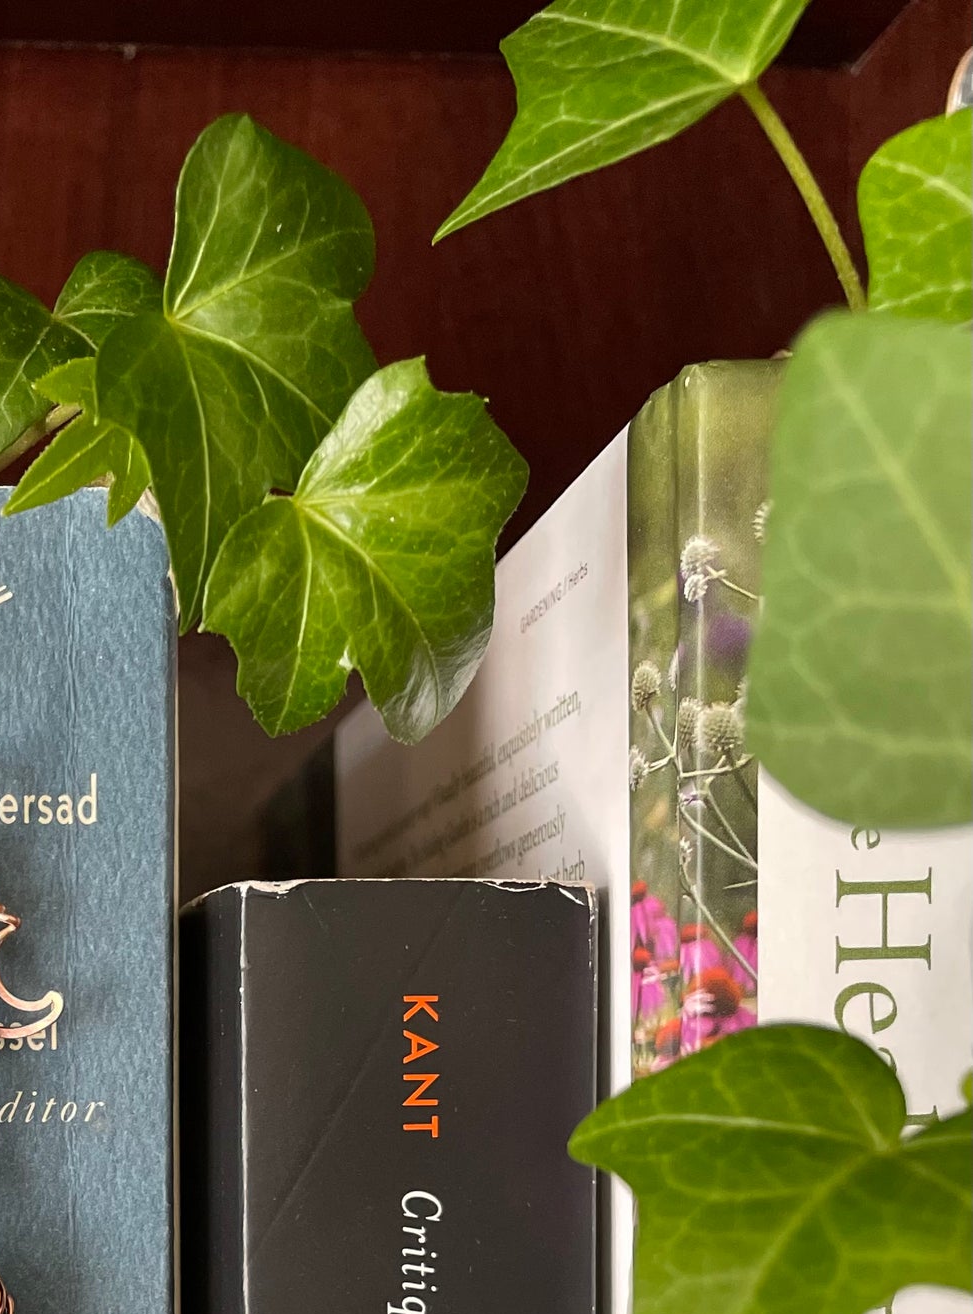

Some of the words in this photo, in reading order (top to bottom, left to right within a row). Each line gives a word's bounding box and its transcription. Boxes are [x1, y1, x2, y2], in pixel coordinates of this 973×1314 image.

[520, 582, 562, 634] GARDENING
[519, 760, 559, 802] delicious
[402, 994, 440, 1138] KANT
